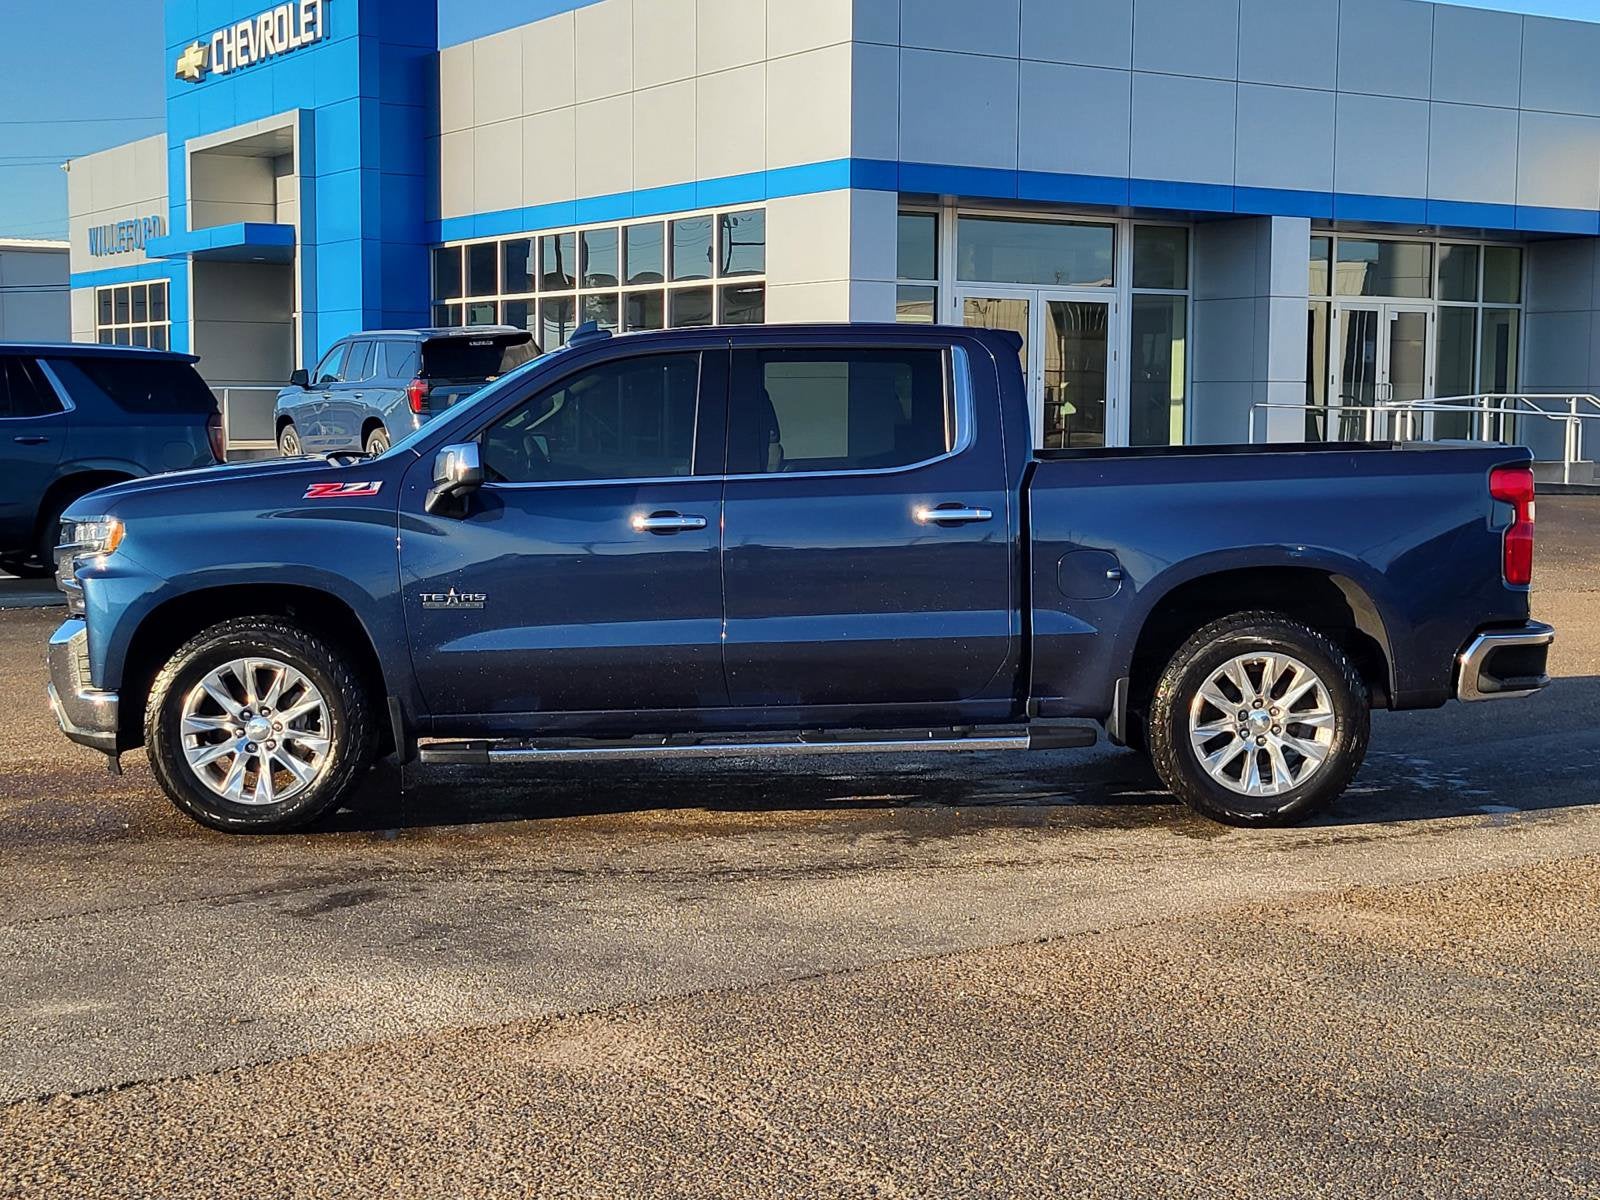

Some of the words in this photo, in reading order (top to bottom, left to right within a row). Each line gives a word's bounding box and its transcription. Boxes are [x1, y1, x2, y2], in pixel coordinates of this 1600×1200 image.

[211, 0, 324, 74] CHEVROLET
[88, 215, 161, 255] WILLEFORD
[302, 480, 383, 499] Z71
[419, 588, 487, 605] TEXAS
